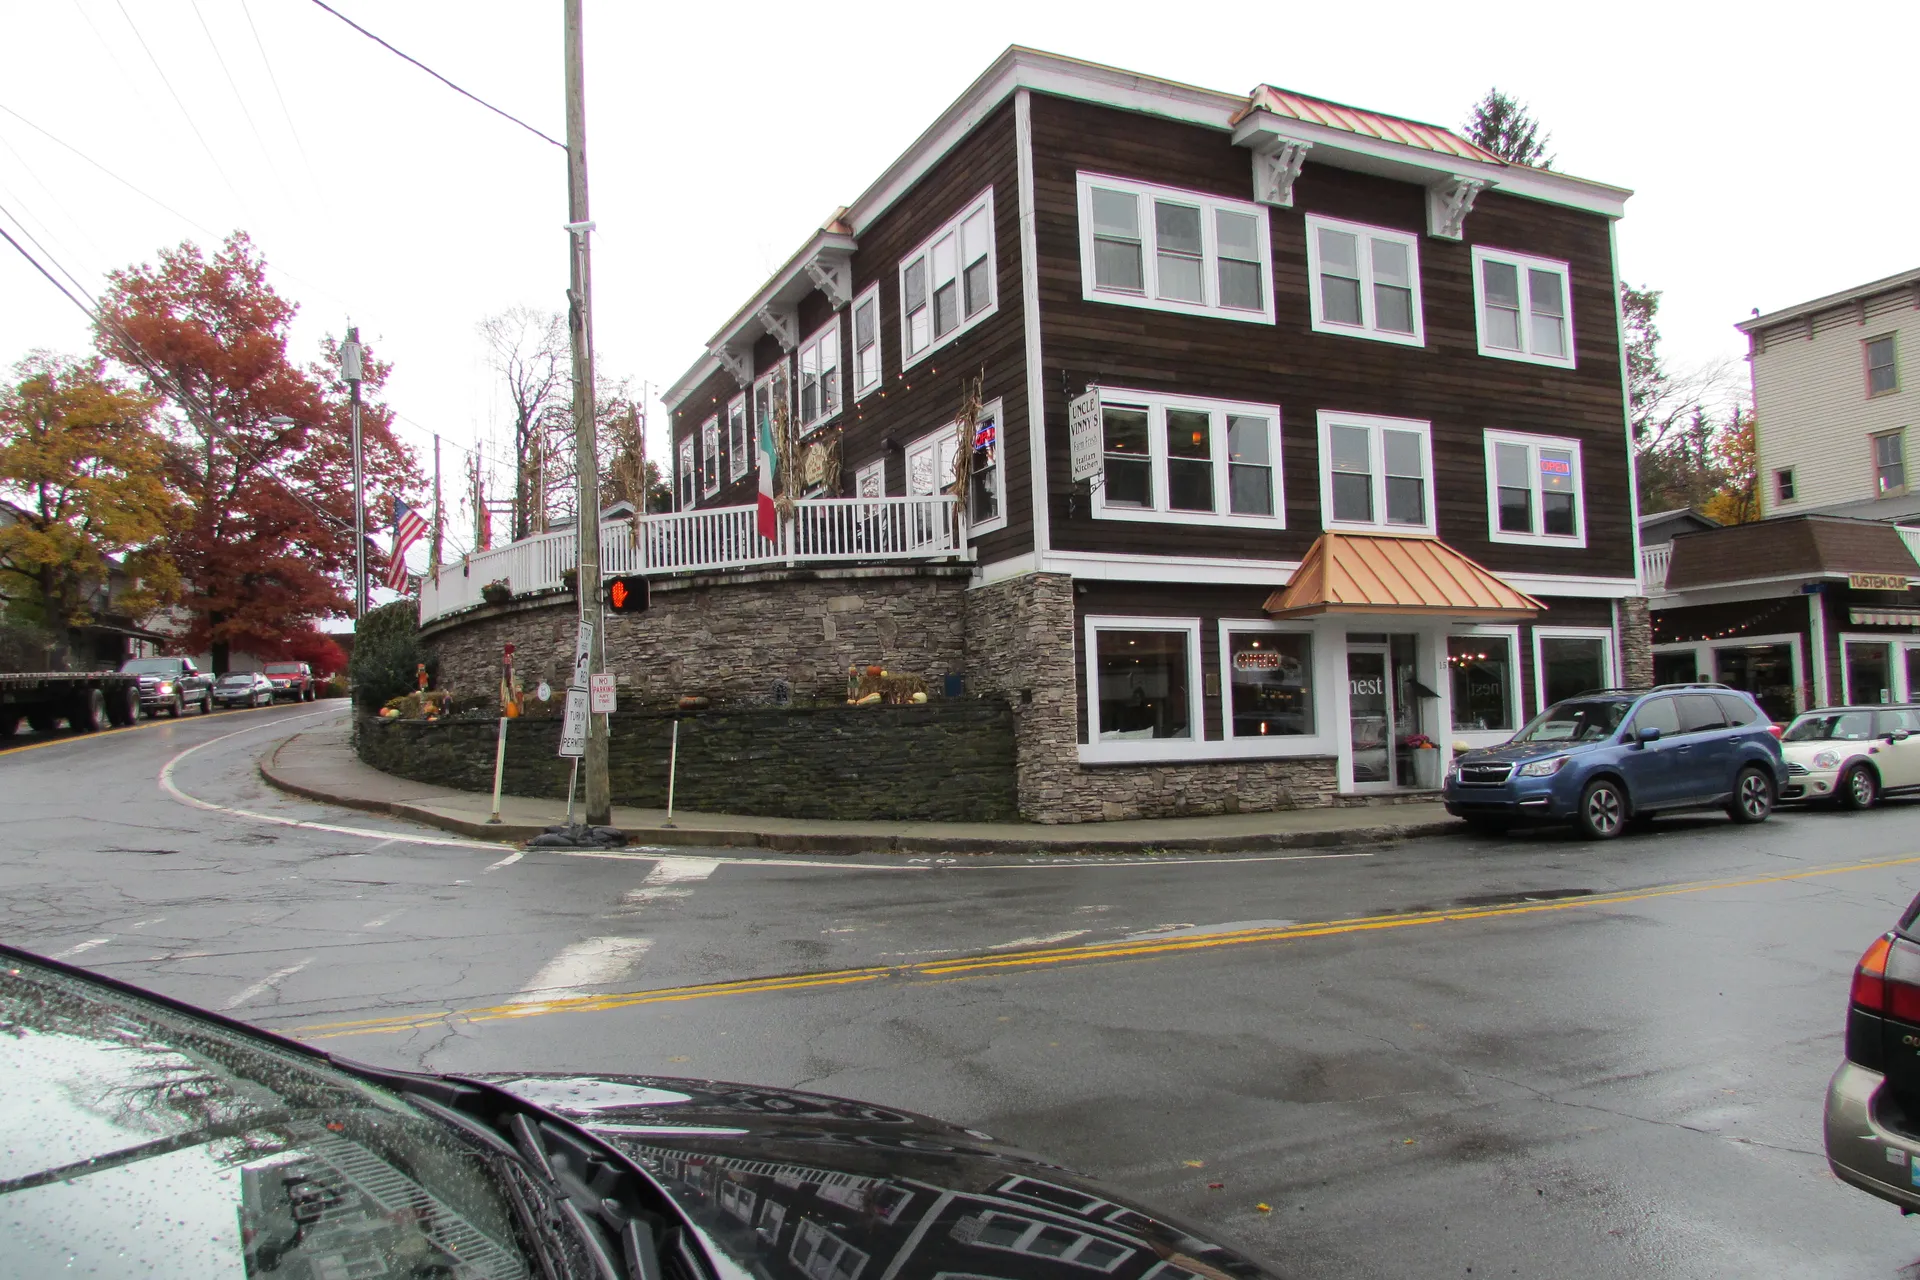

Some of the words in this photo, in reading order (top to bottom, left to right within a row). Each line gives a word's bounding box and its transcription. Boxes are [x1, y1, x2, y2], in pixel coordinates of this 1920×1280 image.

[1072, 398, 1095, 419] UNCLE
[1070, 414, 1099, 436] VINNY'S
[1073, 440, 1085, 452] Farm
[1076, 452, 1096, 465] Italian
[1074, 460, 1099, 474] Kitchen
[1541, 461, 1568, 473] OPEN
[1850, 575, 1886, 588] TUSTEN
[1887, 576, 1907, 589] CUP
[580, 626, 592, 640] STOP
[1236, 652, 1280, 668] OPEN
[598, 677, 608, 685] NO
[1349, 676, 1383, 695] nest
